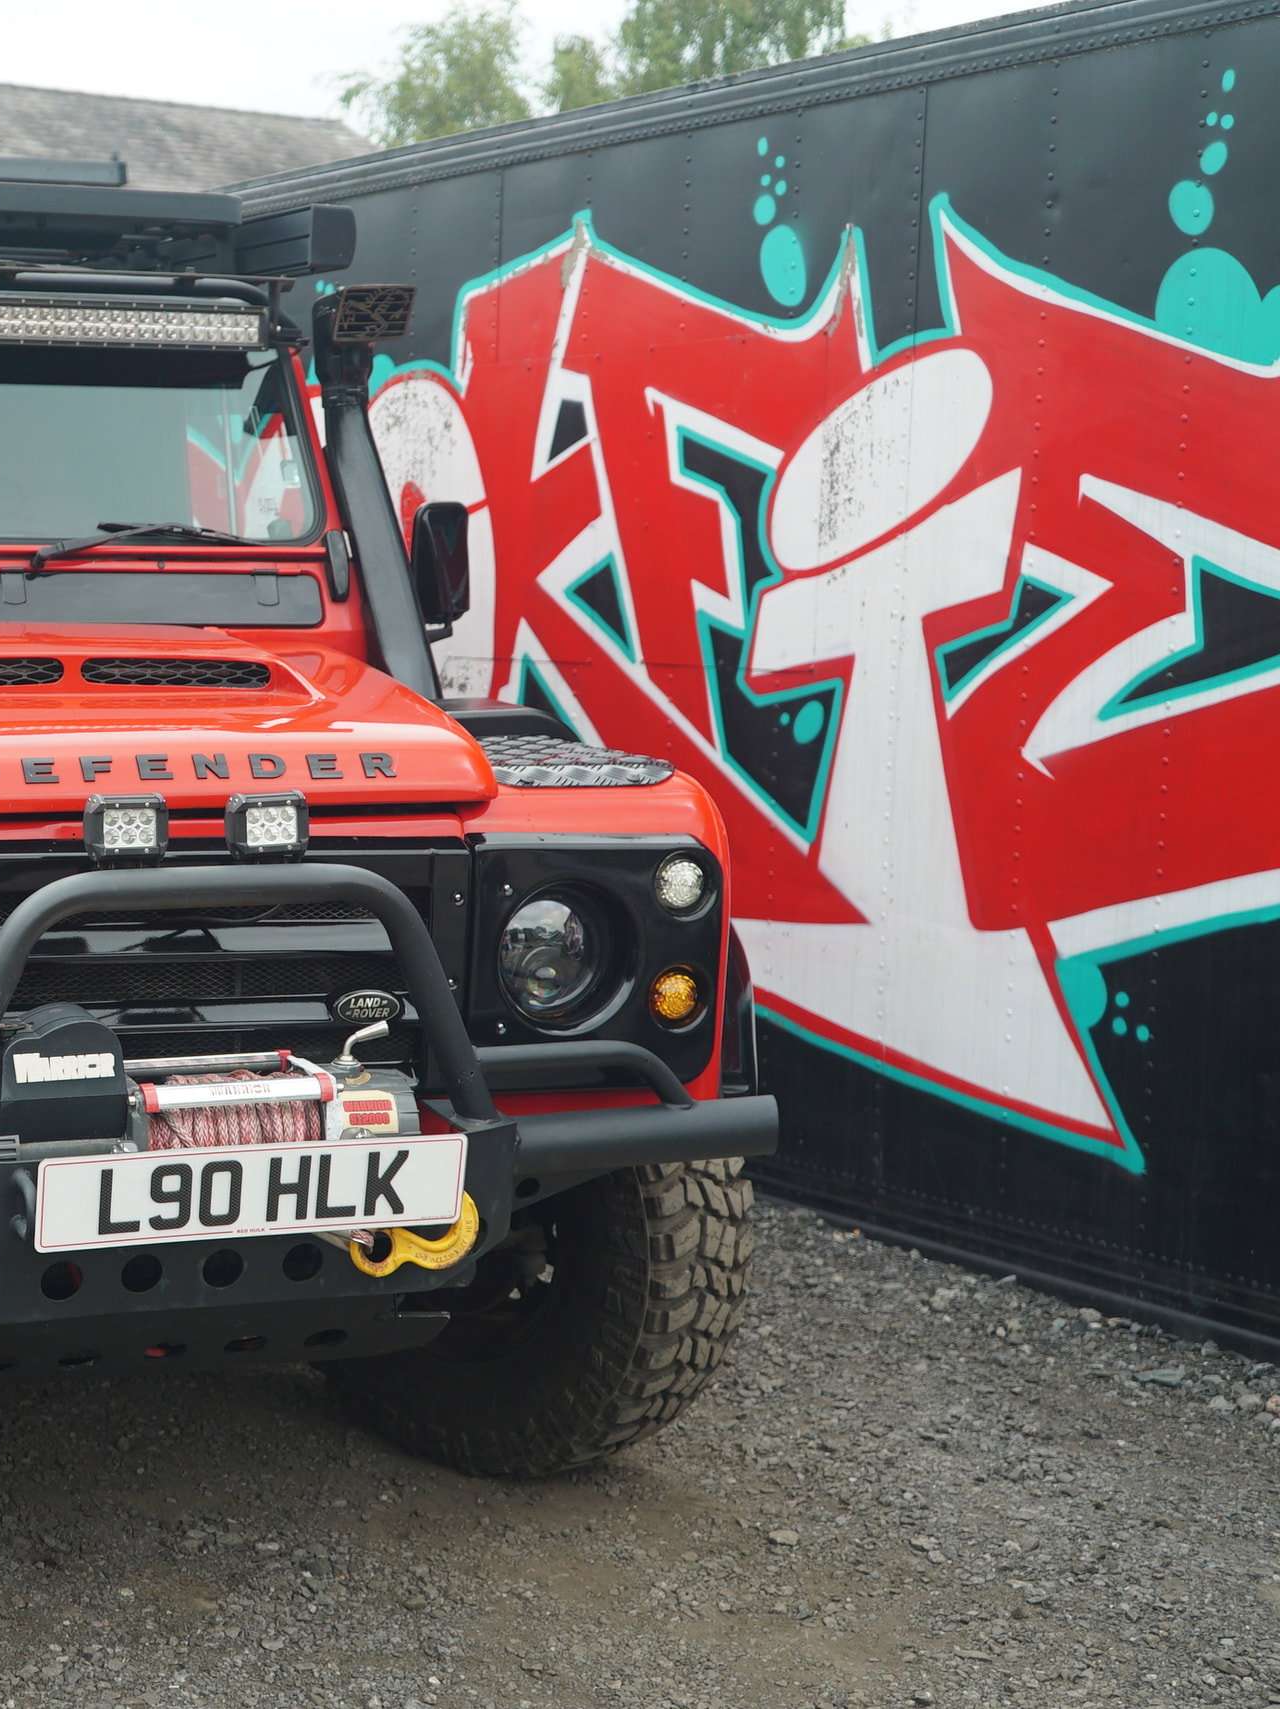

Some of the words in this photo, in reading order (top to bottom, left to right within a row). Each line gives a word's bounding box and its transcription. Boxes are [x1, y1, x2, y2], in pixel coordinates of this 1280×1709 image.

[350, 997, 381, 1009] LAND
[352, 1007, 390, 1018] ROVER
[13, 1053, 115, 1083] WARRIOR
[98, 1159, 243, 1235] L90
[266, 1149, 409, 1222] HLK
